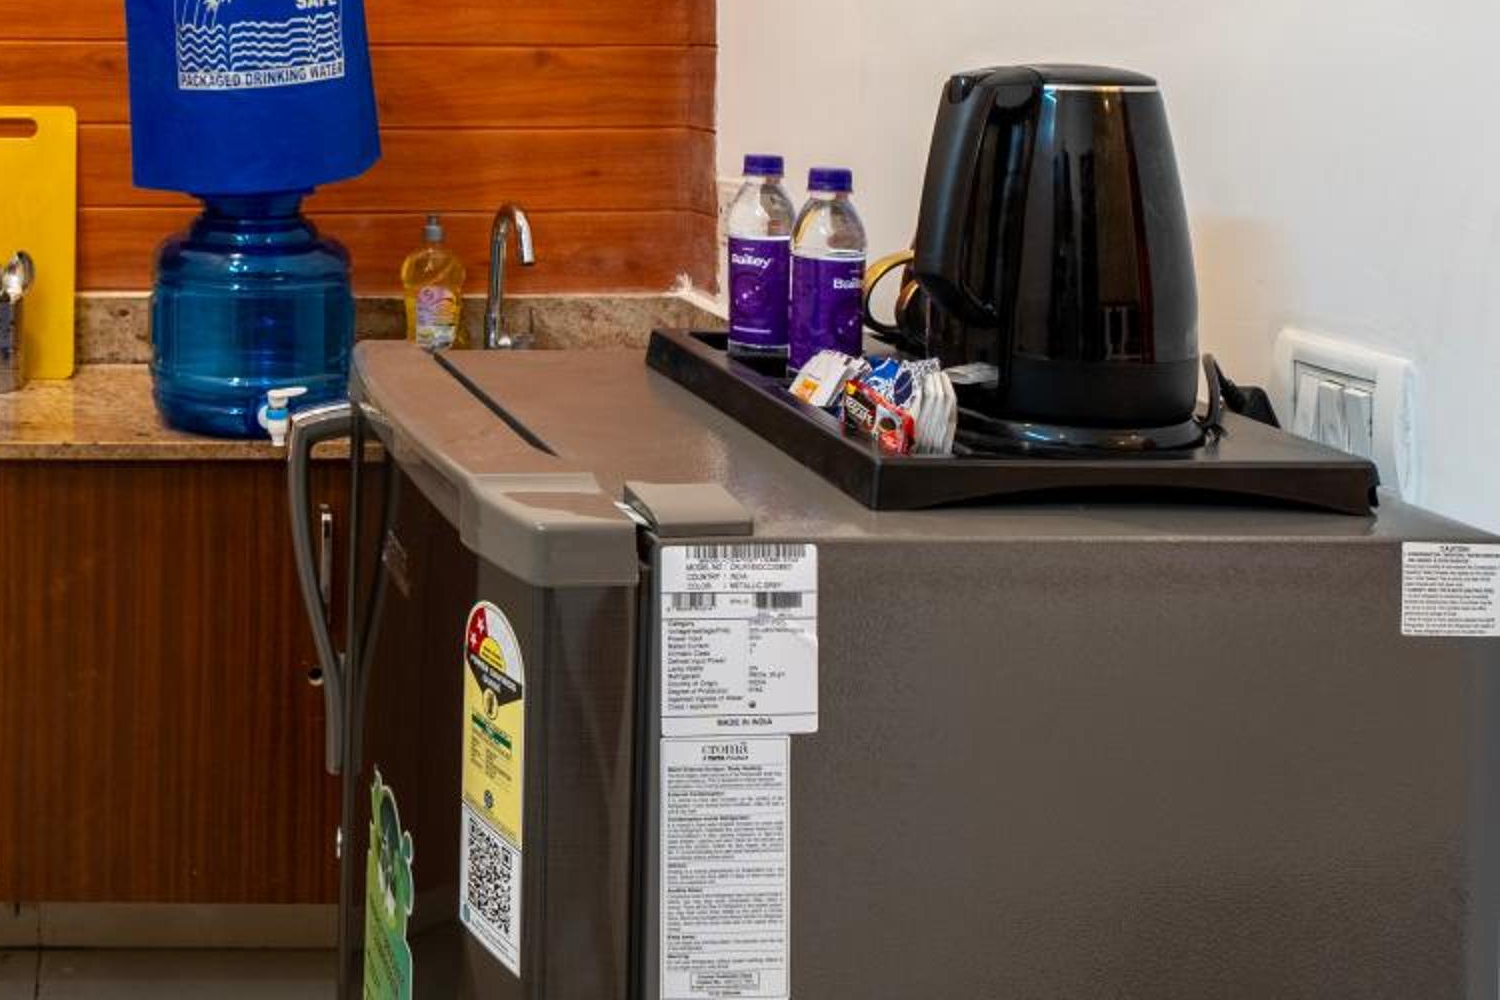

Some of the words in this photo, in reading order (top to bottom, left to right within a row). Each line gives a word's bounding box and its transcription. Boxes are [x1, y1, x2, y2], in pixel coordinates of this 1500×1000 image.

[180, 71, 241, 88] PACKAGED
[245, 67, 307, 85] DRINKING
[309, 62, 344, 79] WATER
